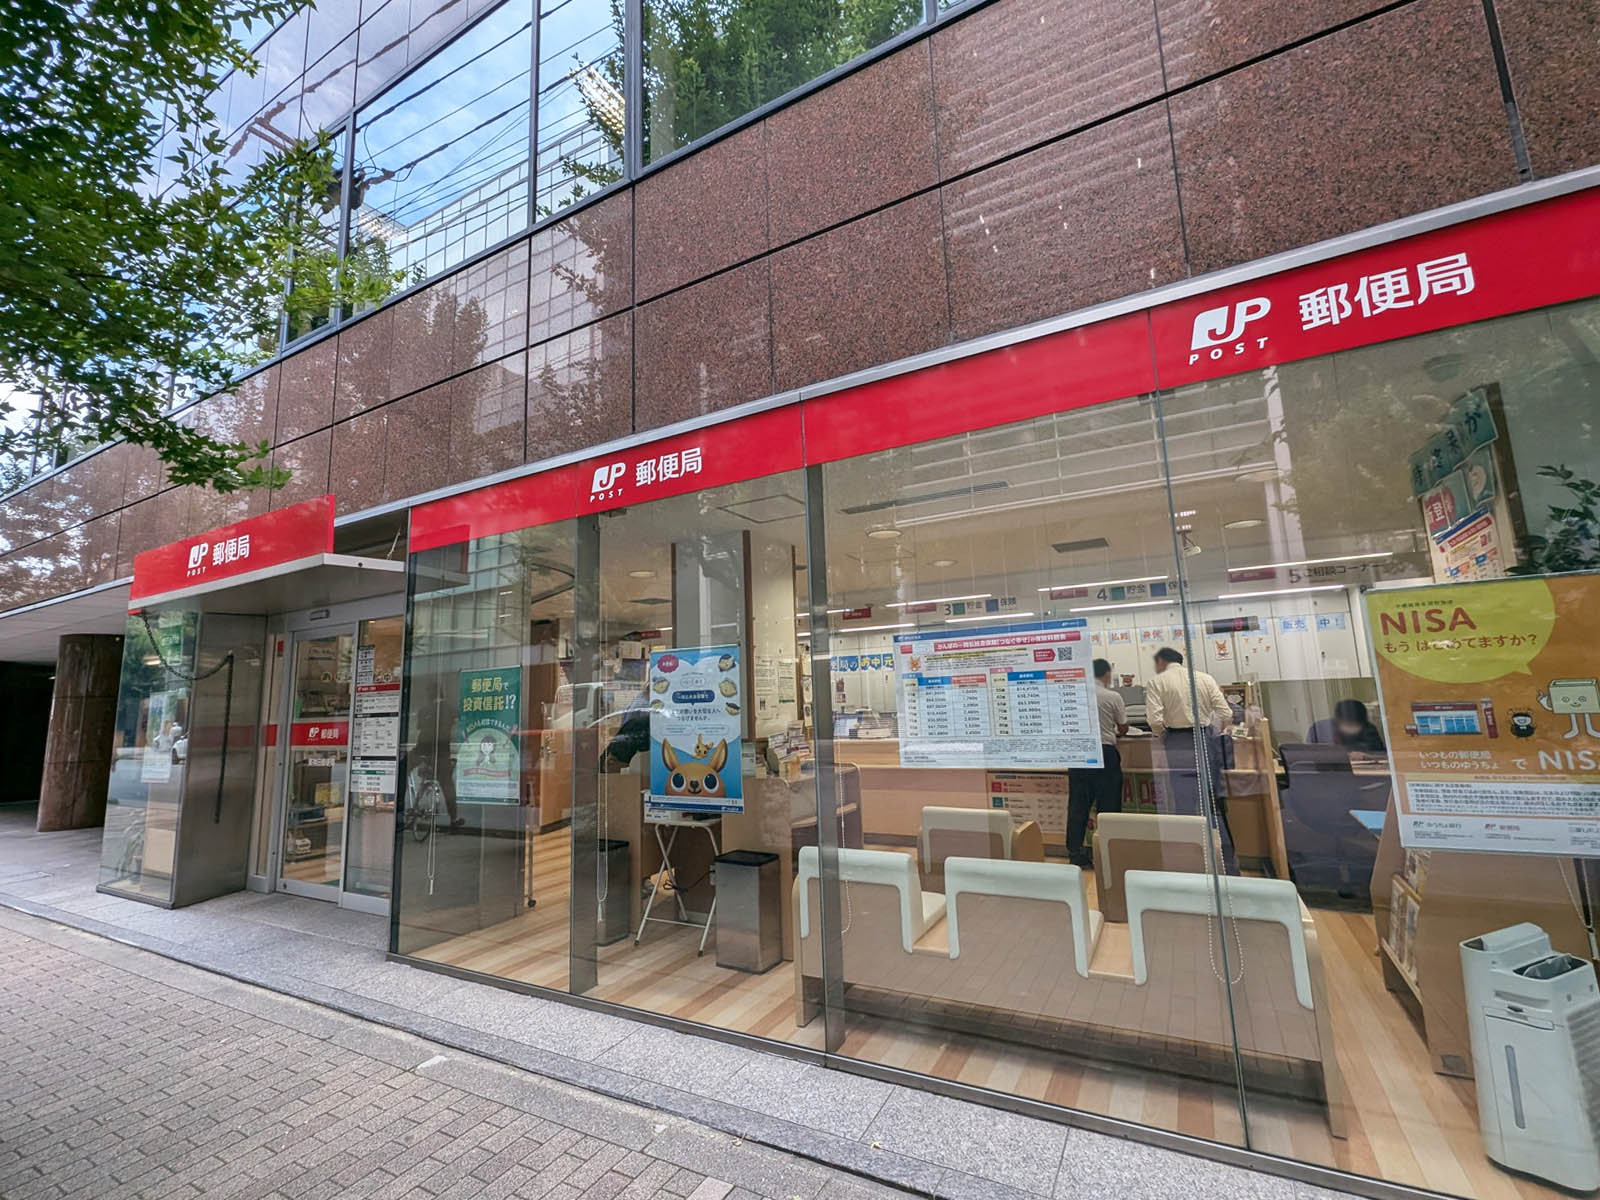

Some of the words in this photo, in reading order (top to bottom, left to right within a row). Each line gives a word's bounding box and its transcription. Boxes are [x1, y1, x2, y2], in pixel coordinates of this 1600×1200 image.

[1299, 252, 1475, 331] 郵便局
[1191, 297, 1271, 350] JP
[1189, 337, 1269, 365] POST
[635, 447, 702, 487] 郵便局
[591, 462, 626, 493] JP
[590, 488, 623, 502] POST
[188, 542, 209, 568] JP
[212, 534, 250, 566] 郵便局
[187, 566, 207, 577] POST
[1289, 569, 1301, 584] 5
[1097, 587, 1107, 600] 4
[944, 604, 951, 615] 3
[1380, 607, 1477, 636] NISA
[1385, 641, 1410, 653] もう
[471, 677, 509, 693] 郵便局で
[1419, 750, 1493, 760] いつもの郵便局
[1538, 750, 1600, 771] NIS
[1421, 760, 1500, 770] いつものゆうちょ
